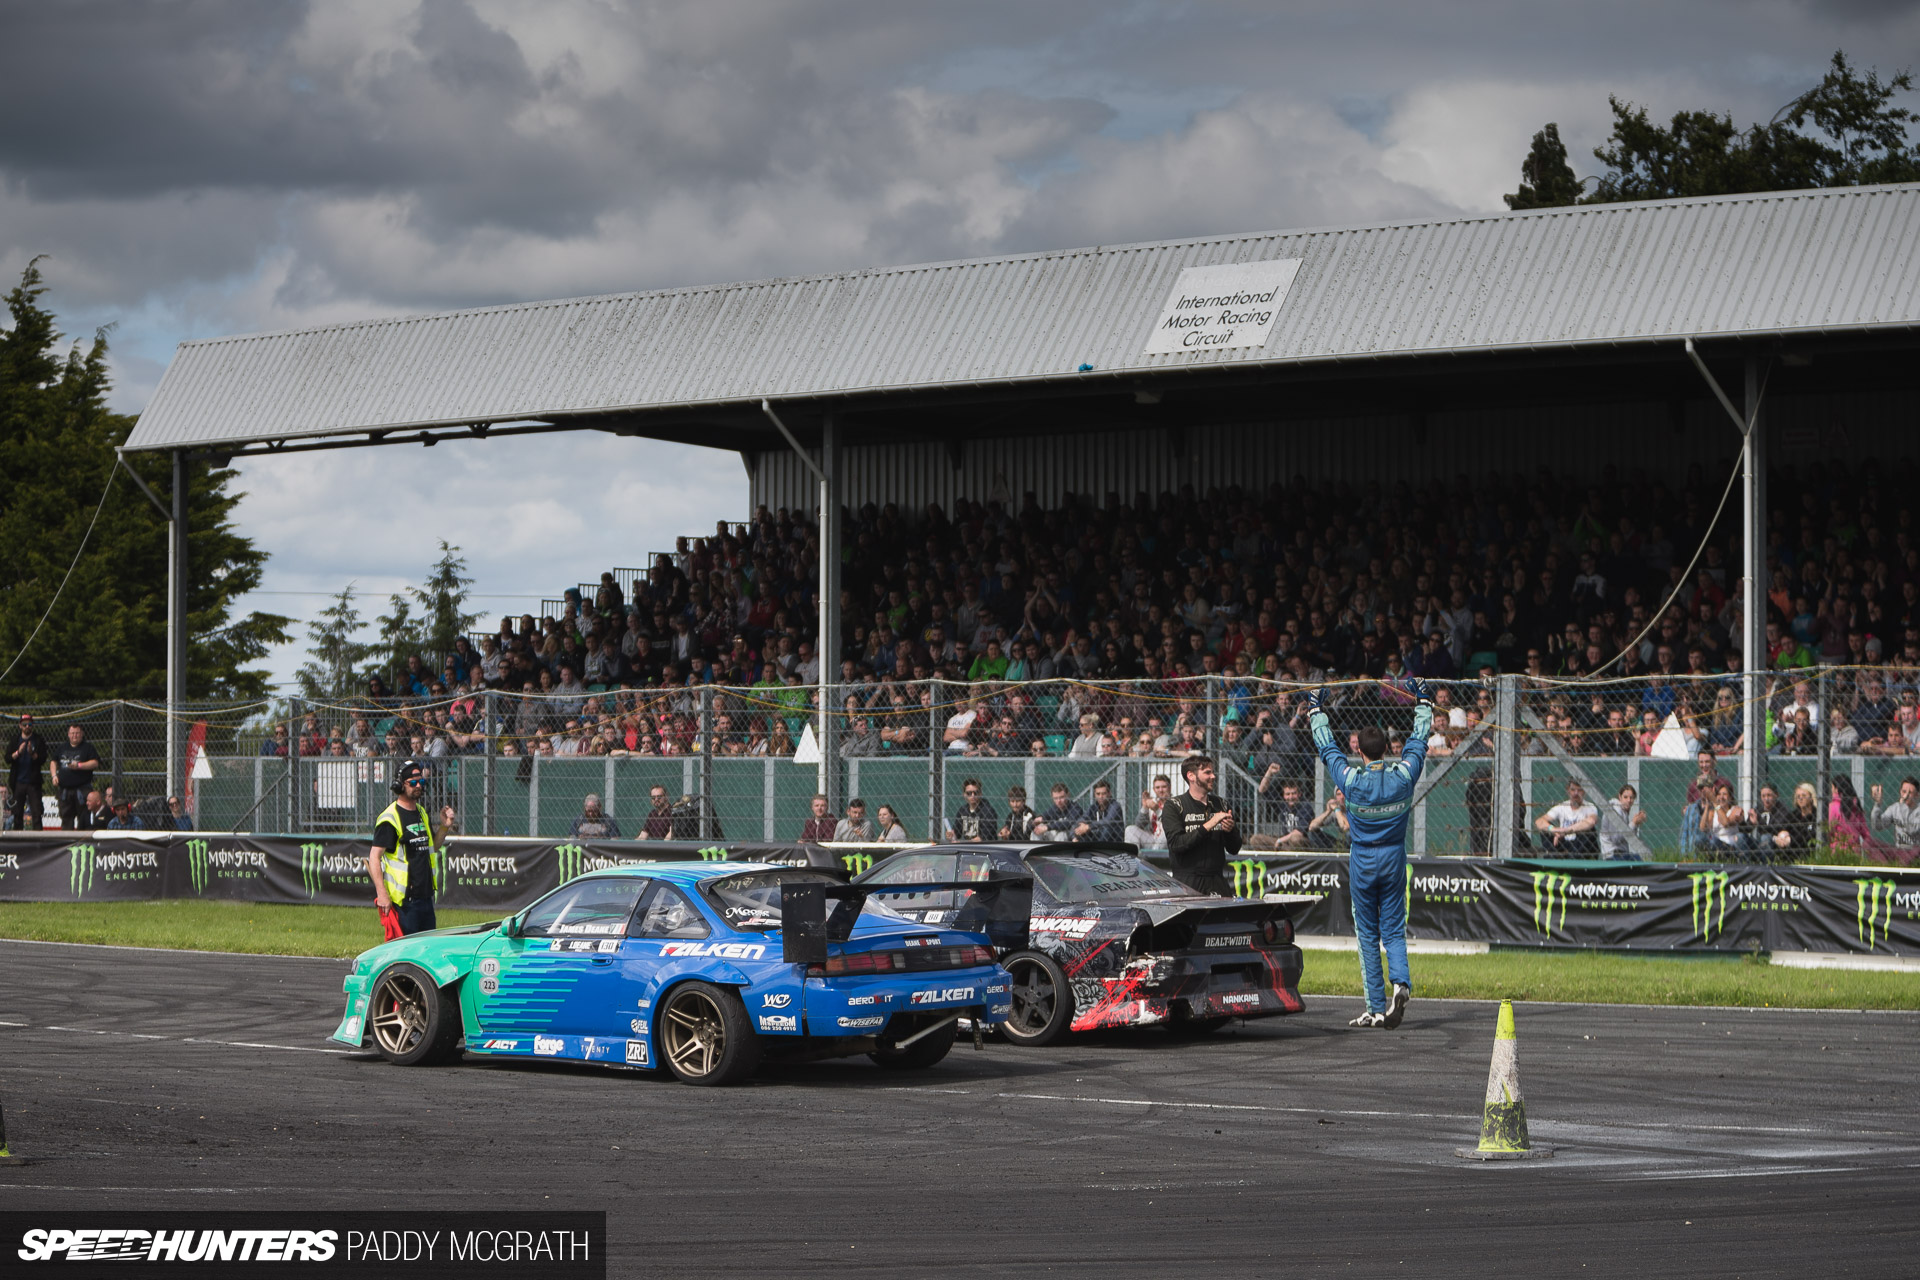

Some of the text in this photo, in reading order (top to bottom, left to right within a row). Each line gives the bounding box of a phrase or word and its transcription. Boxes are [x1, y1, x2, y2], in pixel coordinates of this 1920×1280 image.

[1175, 285, 1280, 310] International
[1161, 309, 1273, 330] Motor Racing
[1182, 329, 1234, 347] Circuit
[1358, 802, 1406, 815] FALKEN
[95, 850, 158, 871] MONSTER
[208, 847, 268, 869] MONSTER
[447, 853, 518, 875] MONSTER
[105, 872, 152, 881] ENERGY
[217, 870, 259, 879] ENERGY
[331, 875, 369, 884] ENERG
[458, 876, 507, 886] ENERGY
[1266, 870, 1341, 889] MONSTER
[1413, 875, 1491, 895] MONSTER
[1569, 882, 1650, 900] MONSTER
[1729, 880, 1812, 902] MONSTER
[1425, 894, 1480, 904] ENERGY
[1581, 901, 1638, 910] ENERGY
[1741, 902, 1799, 912] ENERGY
[559, 924, 610, 934] JAMES DEANE
[659, 942, 766, 960] FALKEN
[484, 963, 495, 972] 173
[484, 980, 496, 990] 223
[761, 994, 792, 1009] WCP
[910, 987, 975, 1005] FALKEN
[1222, 993, 1260, 1005] NANKANG
[491, 1040, 518, 1050] ACT
[627, 1043, 646, 1061] ZRP
